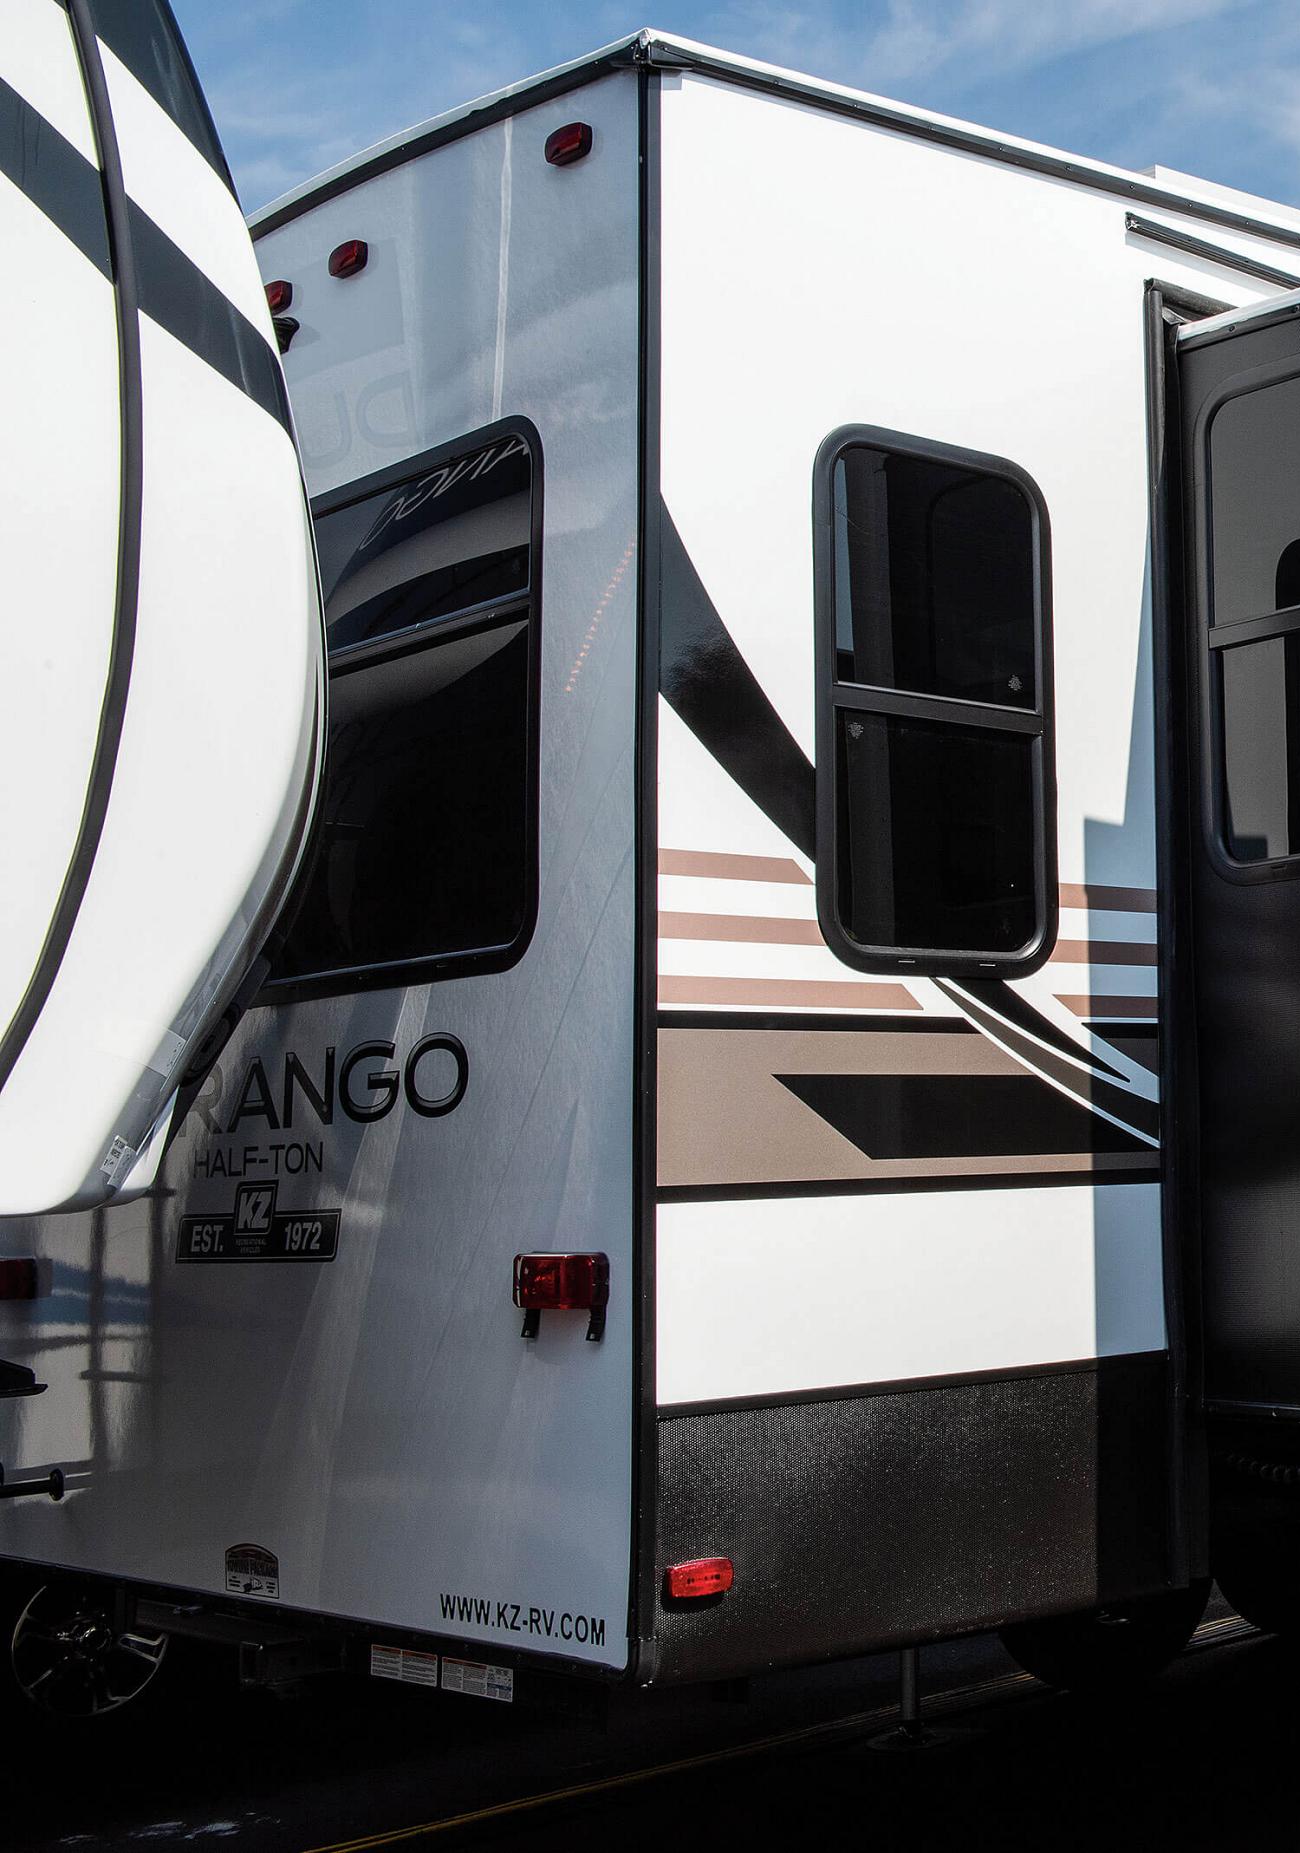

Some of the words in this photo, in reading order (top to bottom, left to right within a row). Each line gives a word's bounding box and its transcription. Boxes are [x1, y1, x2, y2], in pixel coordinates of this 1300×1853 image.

[192, 1142, 324, 1178] HALF-TON
[237, 1191, 272, 1230] KZ
[190, 1224, 225, 1253] EST.
[284, 1222, 322, 1251] 1972
[439, 1593, 606, 1647] WWW.KZ-RV.COM
